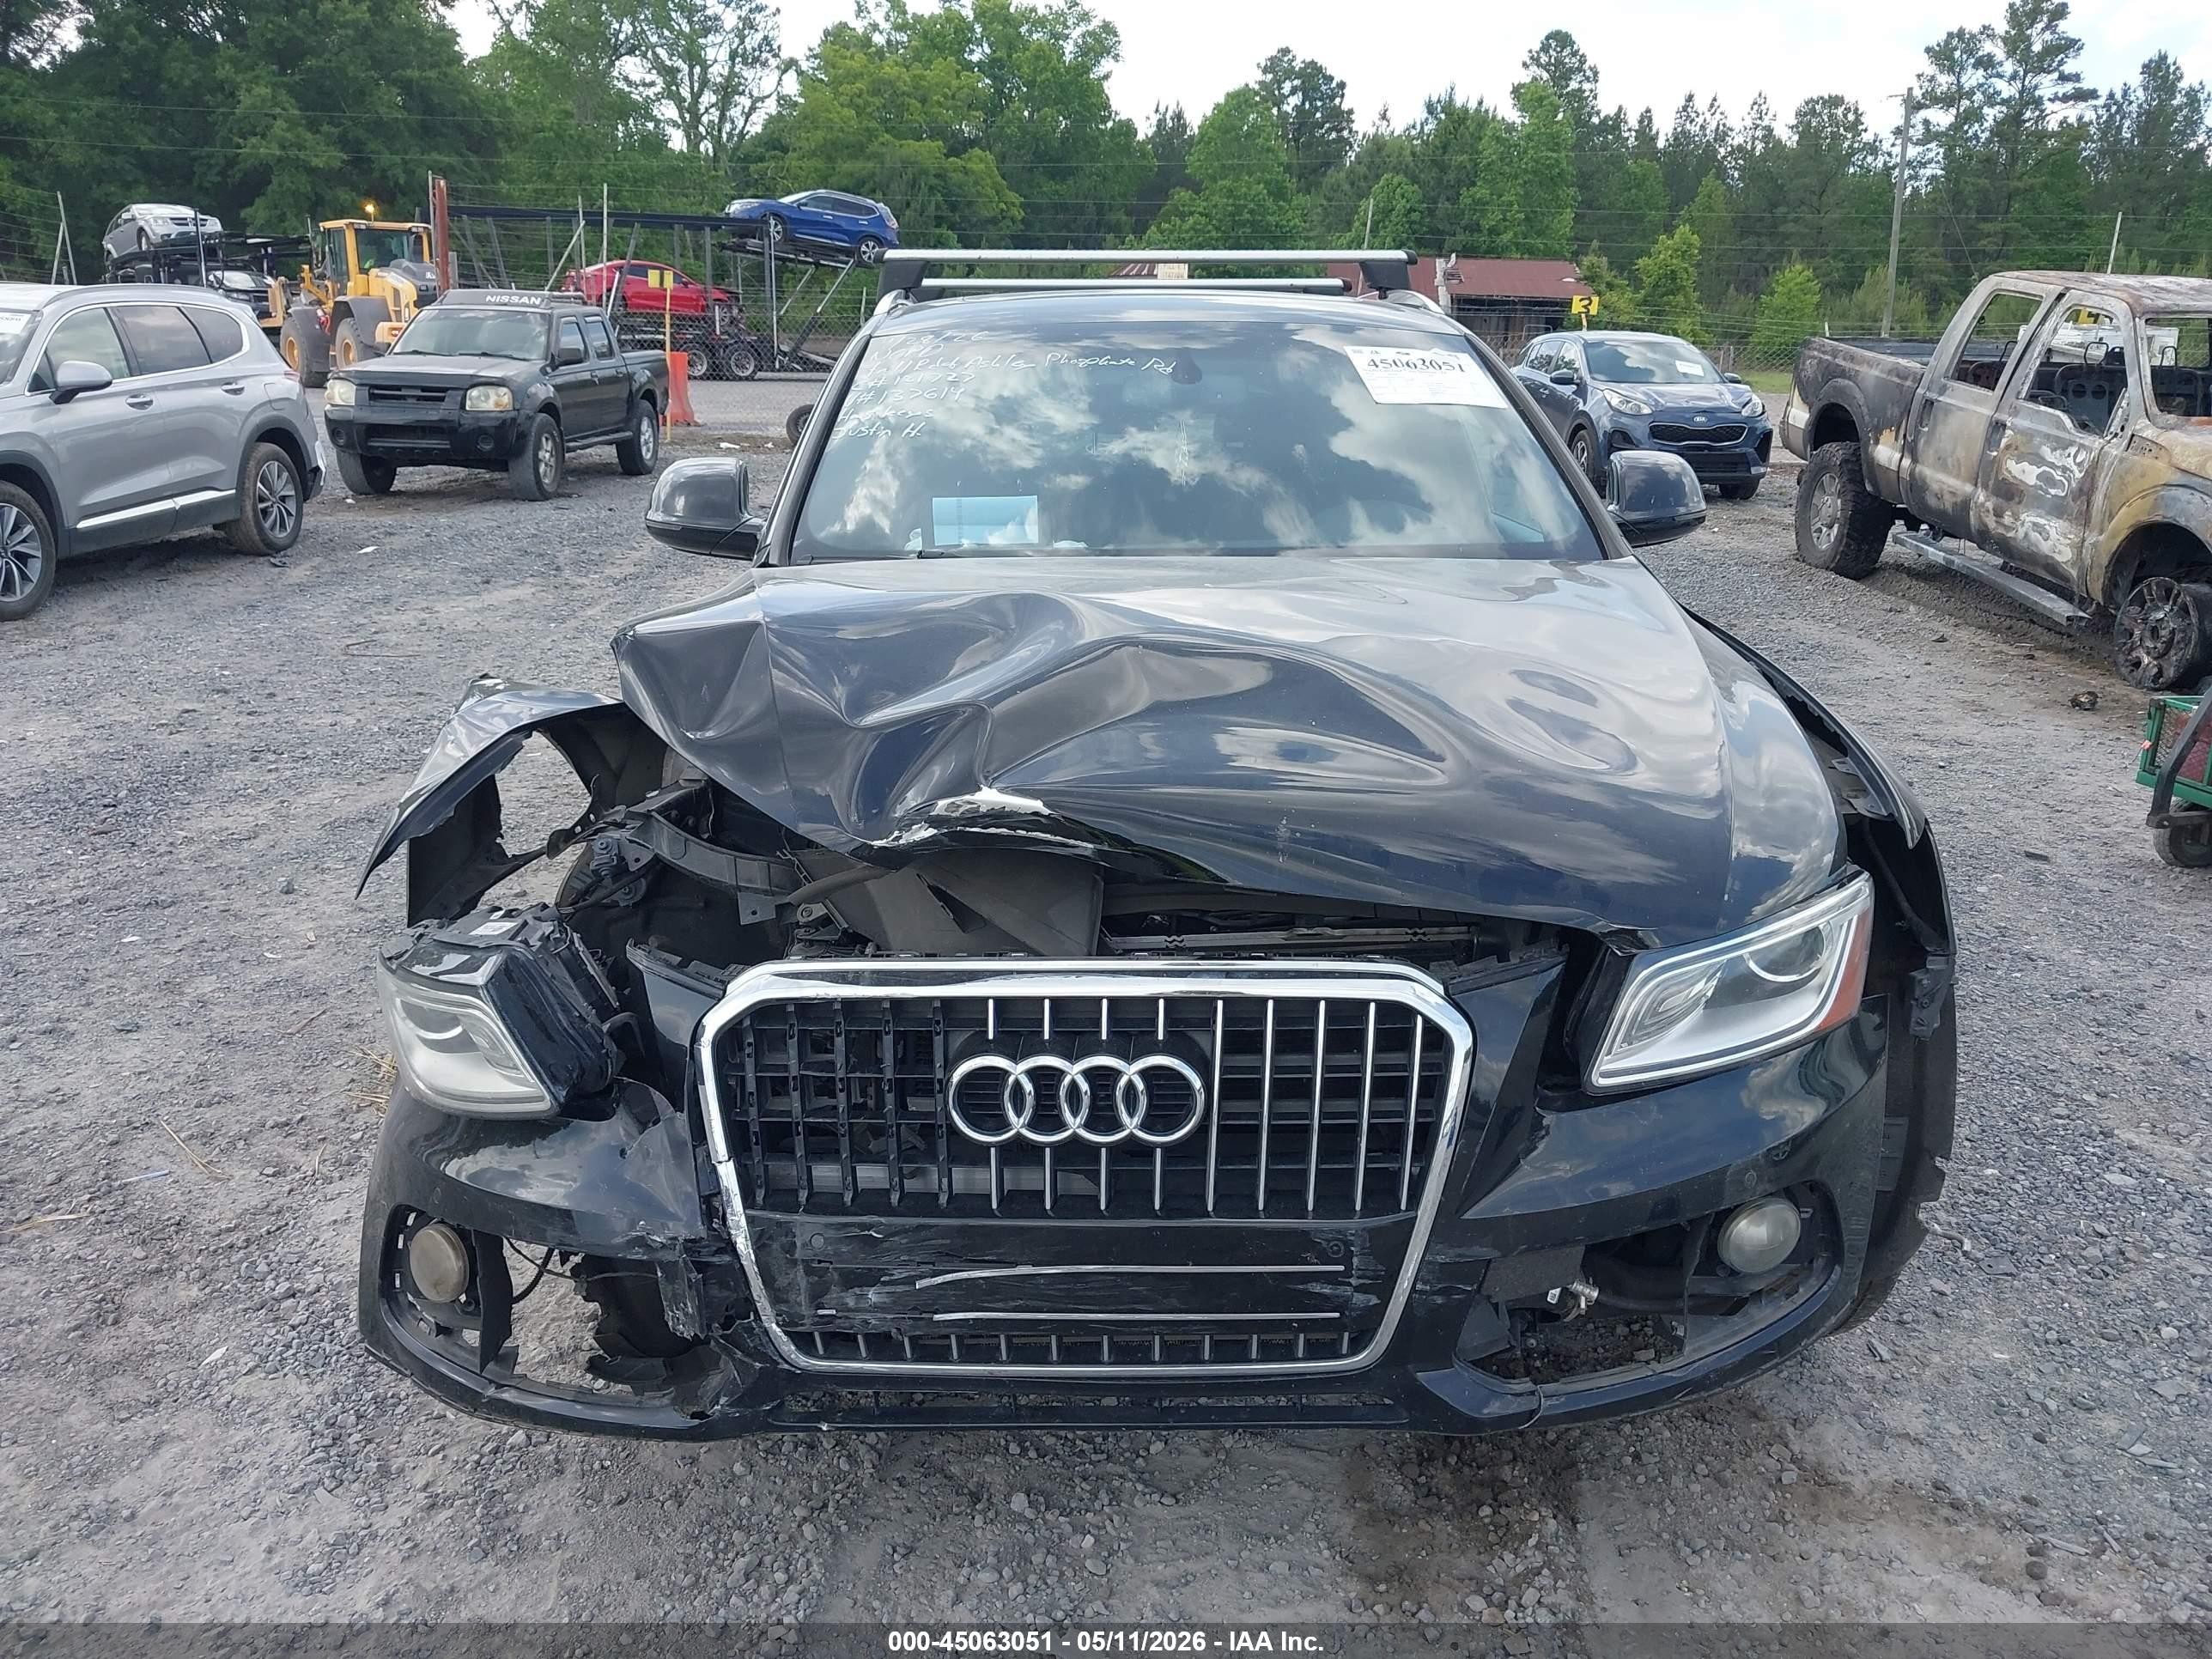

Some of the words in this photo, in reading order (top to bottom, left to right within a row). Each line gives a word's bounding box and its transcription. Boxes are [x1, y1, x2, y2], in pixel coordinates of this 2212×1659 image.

[486, 295, 541, 305] NISSAN
[1578, 297, 1592, 313] 3
[1368, 358, 1465, 372] 45063051
